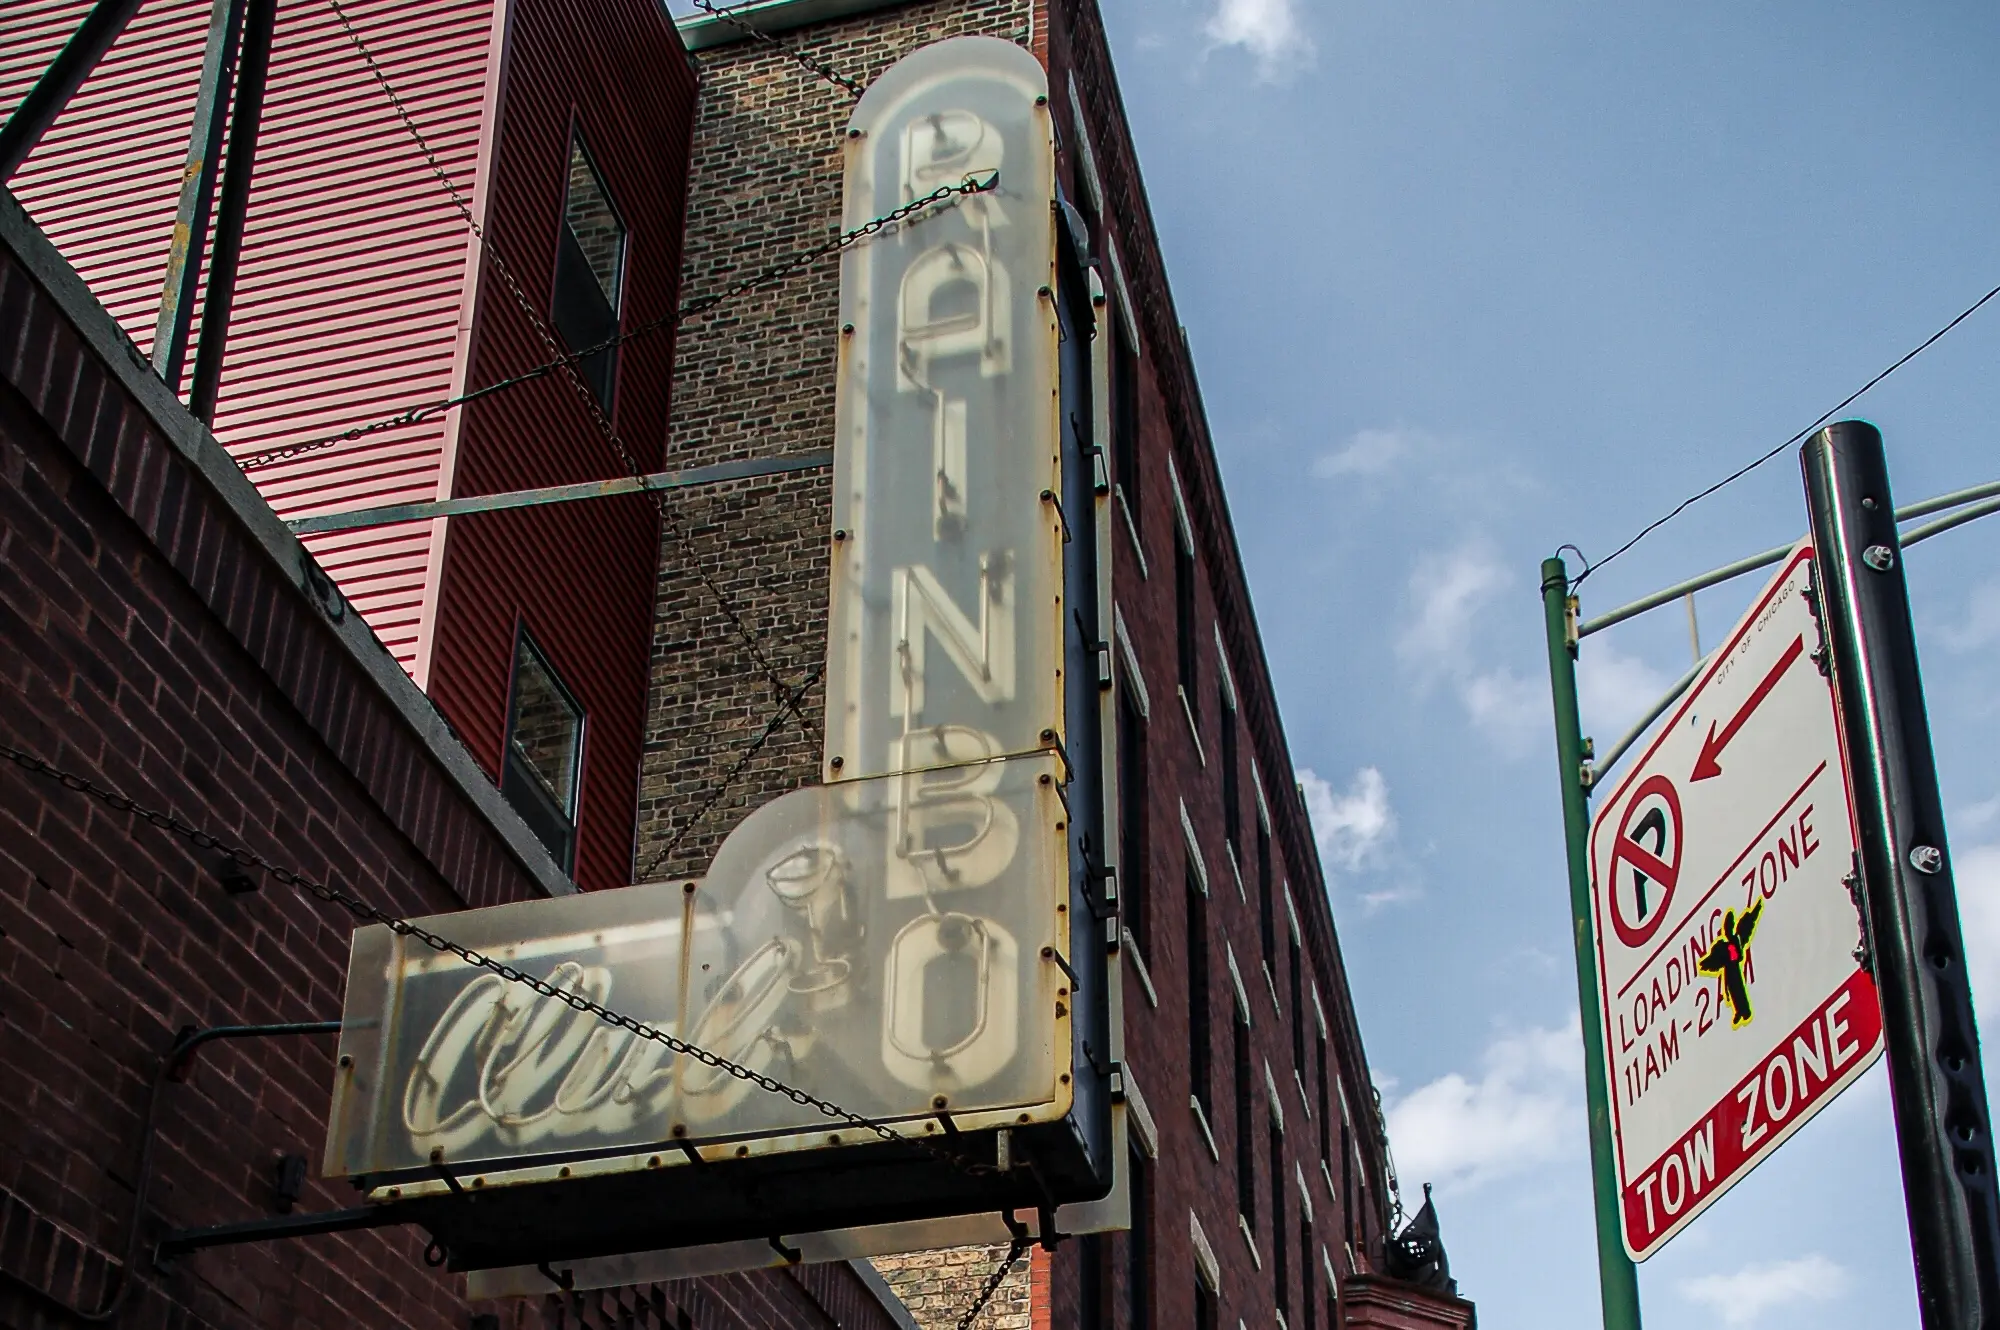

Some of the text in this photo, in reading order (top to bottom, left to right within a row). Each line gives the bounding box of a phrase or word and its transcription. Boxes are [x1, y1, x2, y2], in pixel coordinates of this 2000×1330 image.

[881, 110, 1020, 1092] RAINBO
[1717, 580, 1795, 685] CITY OF CHICAGO
[1742, 804, 1820, 908] ZONE
[1637, 990, 1859, 1234] TOW ZONE
